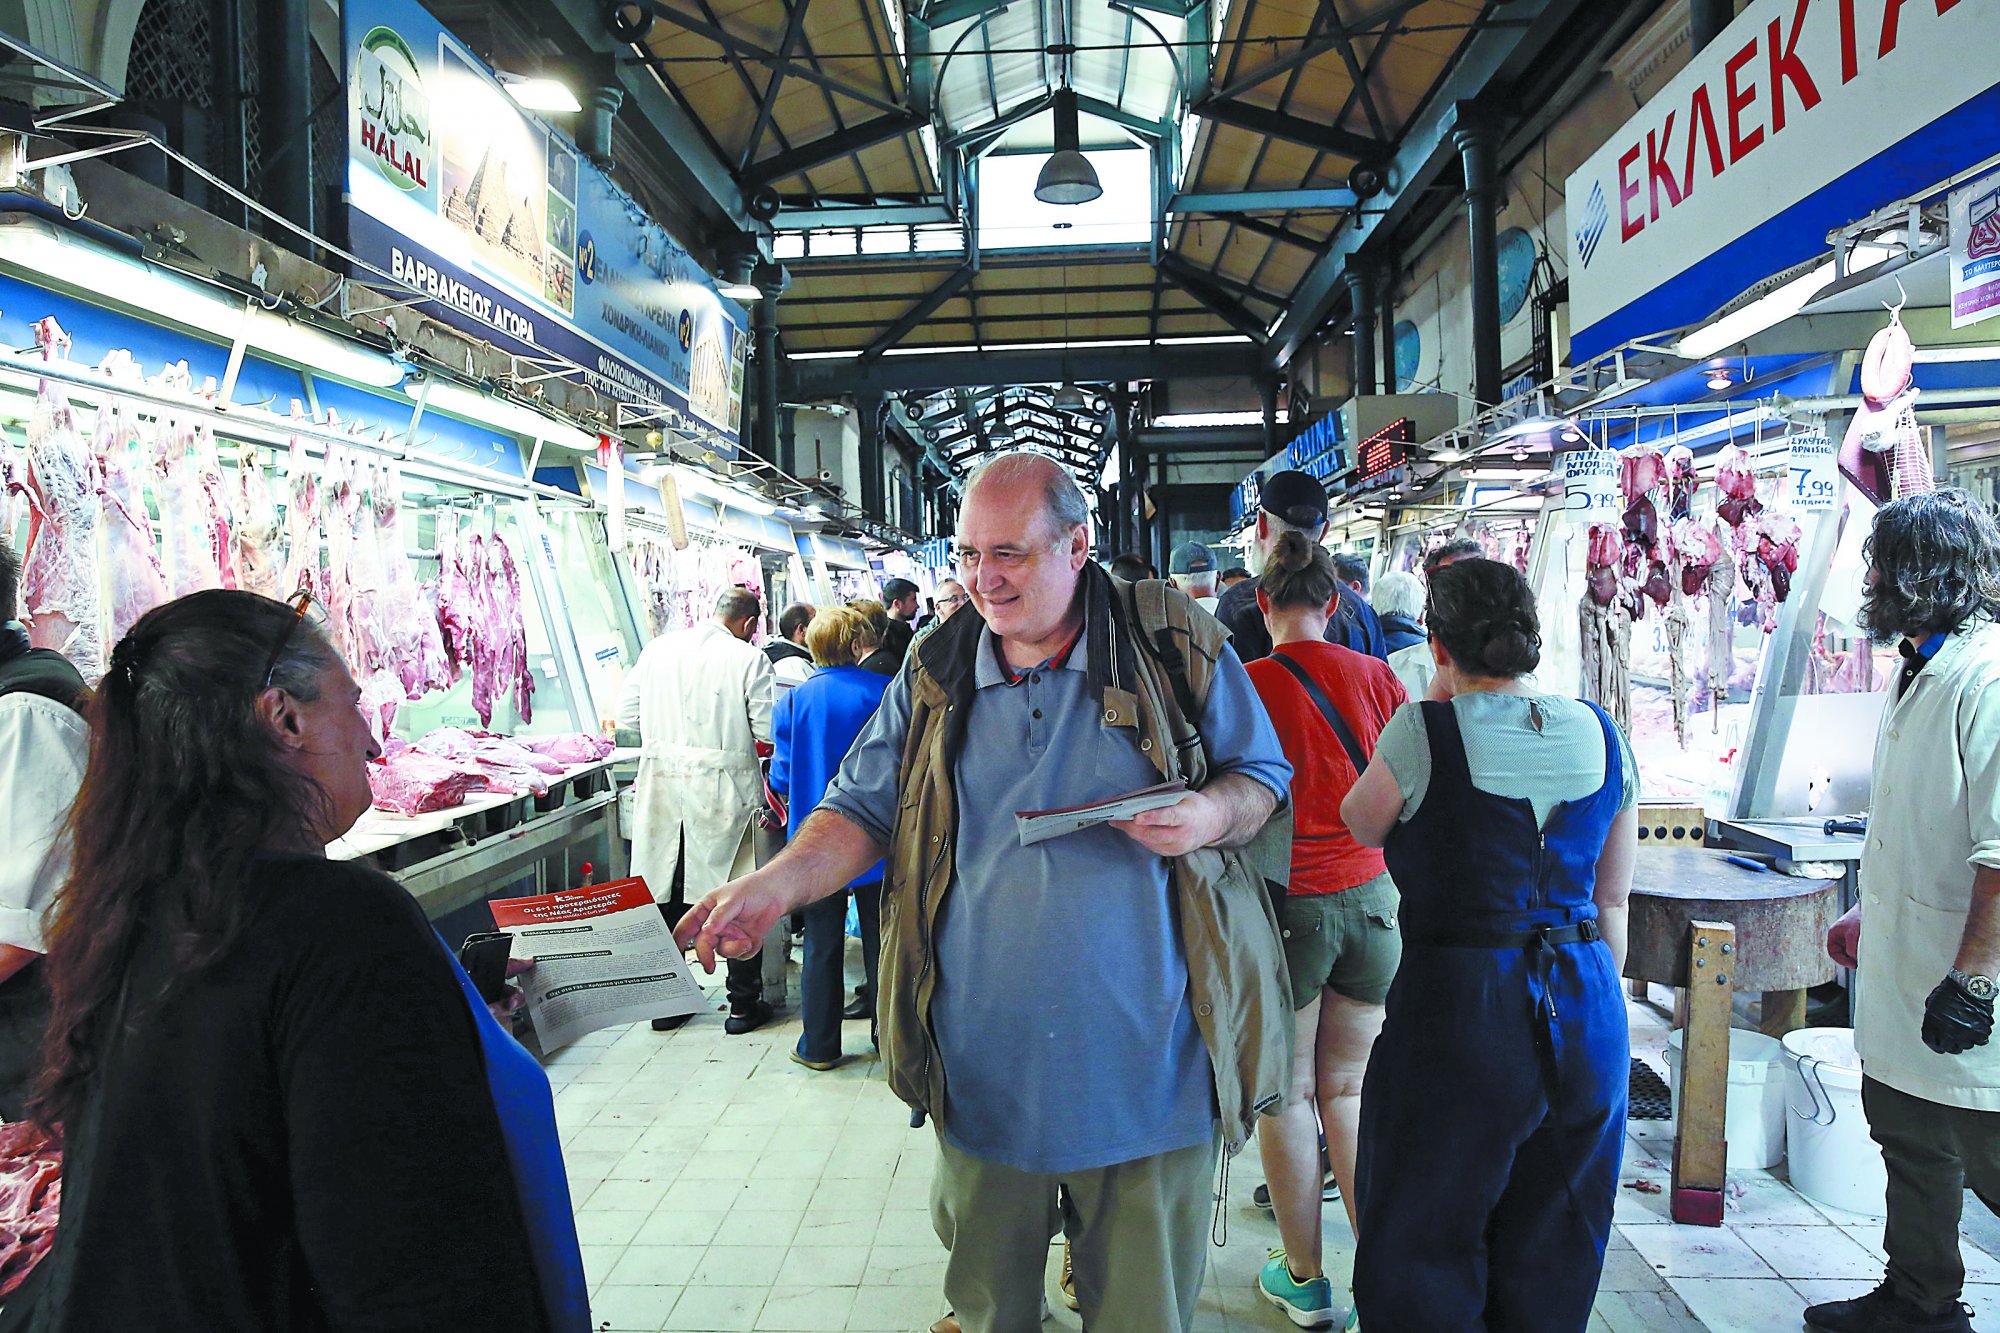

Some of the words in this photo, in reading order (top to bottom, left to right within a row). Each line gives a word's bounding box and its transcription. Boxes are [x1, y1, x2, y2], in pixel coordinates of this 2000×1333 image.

[361, 118, 427, 188] HALAL
[1965, 268, 1974, 277] ΤΟ
[391, 248, 492, 323] ΒΑΡΒΑΚΕΙΟΣ
[493, 304, 536, 344] ΑΓΟΡΑ
[1789, 467, 1834, 498] 7,99
[1565, 483, 1616, 511] 5,99
[532, 911, 549, 919] της
[549, 909, 573, 917] Νέας
[573, 899, 618, 913] Αριστεράς
[552, 891, 622, 910] προτεραιότητες
